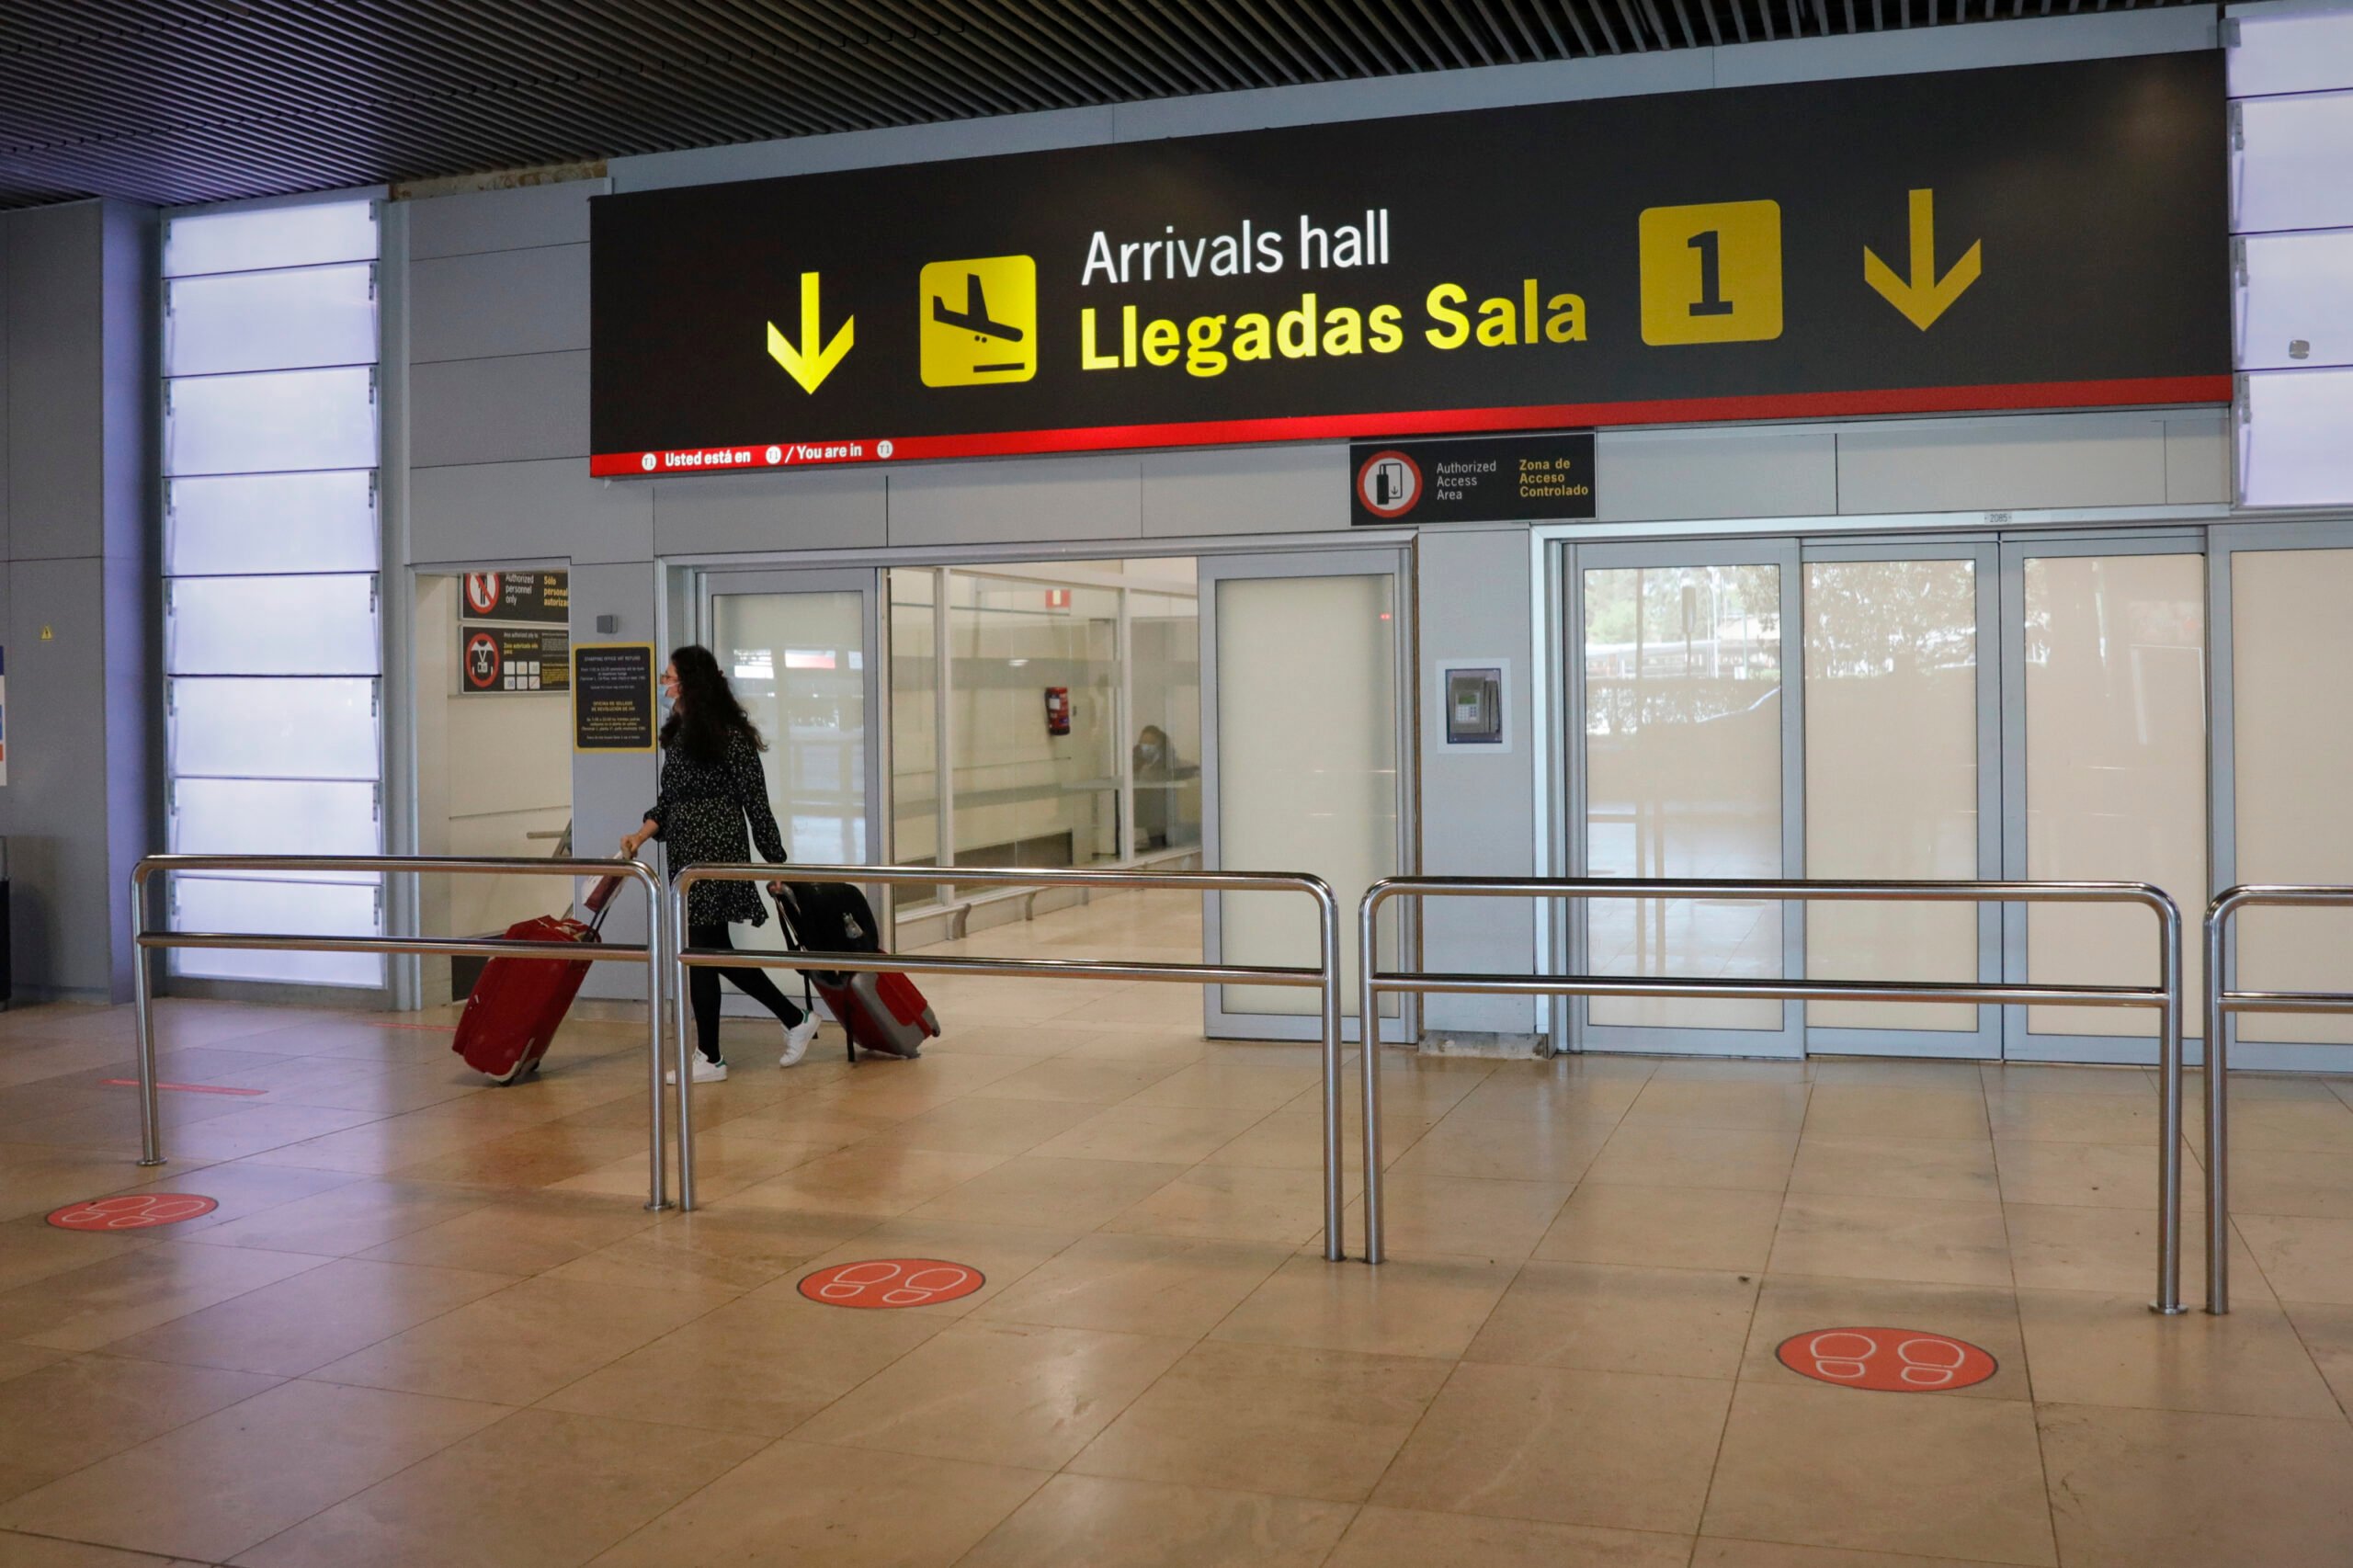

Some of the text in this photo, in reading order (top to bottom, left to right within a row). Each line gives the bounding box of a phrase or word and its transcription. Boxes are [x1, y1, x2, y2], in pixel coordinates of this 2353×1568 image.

[1081, 208, 1389, 286] Arrivals hall
[1687, 230, 1733, 317] 1
[1081, 278, 1587, 378] Llegadas Sala
[665, 450, 701, 467] Usted
[703, 449, 733, 465] está
[734, 450, 752, 463] en
[796, 445, 823, 460] You
[825, 446, 847, 459] are
[849, 442, 862, 457] in
[1437, 460, 1496, 473] Authorized
[1519, 458, 1570, 471] Zona de
[1437, 476, 1477, 487] Access
[1519, 472, 1565, 483] Acceso
[1437, 489, 1462, 500] Area
[1519, 484, 1588, 497] Controlado
[1989, 513, 2007, 523] 2085
[506, 574, 534, 585] Authorized
[506, 585, 532, 596] personnel
[544, 587, 568, 597] personal
[506, 595, 517, 606] only
